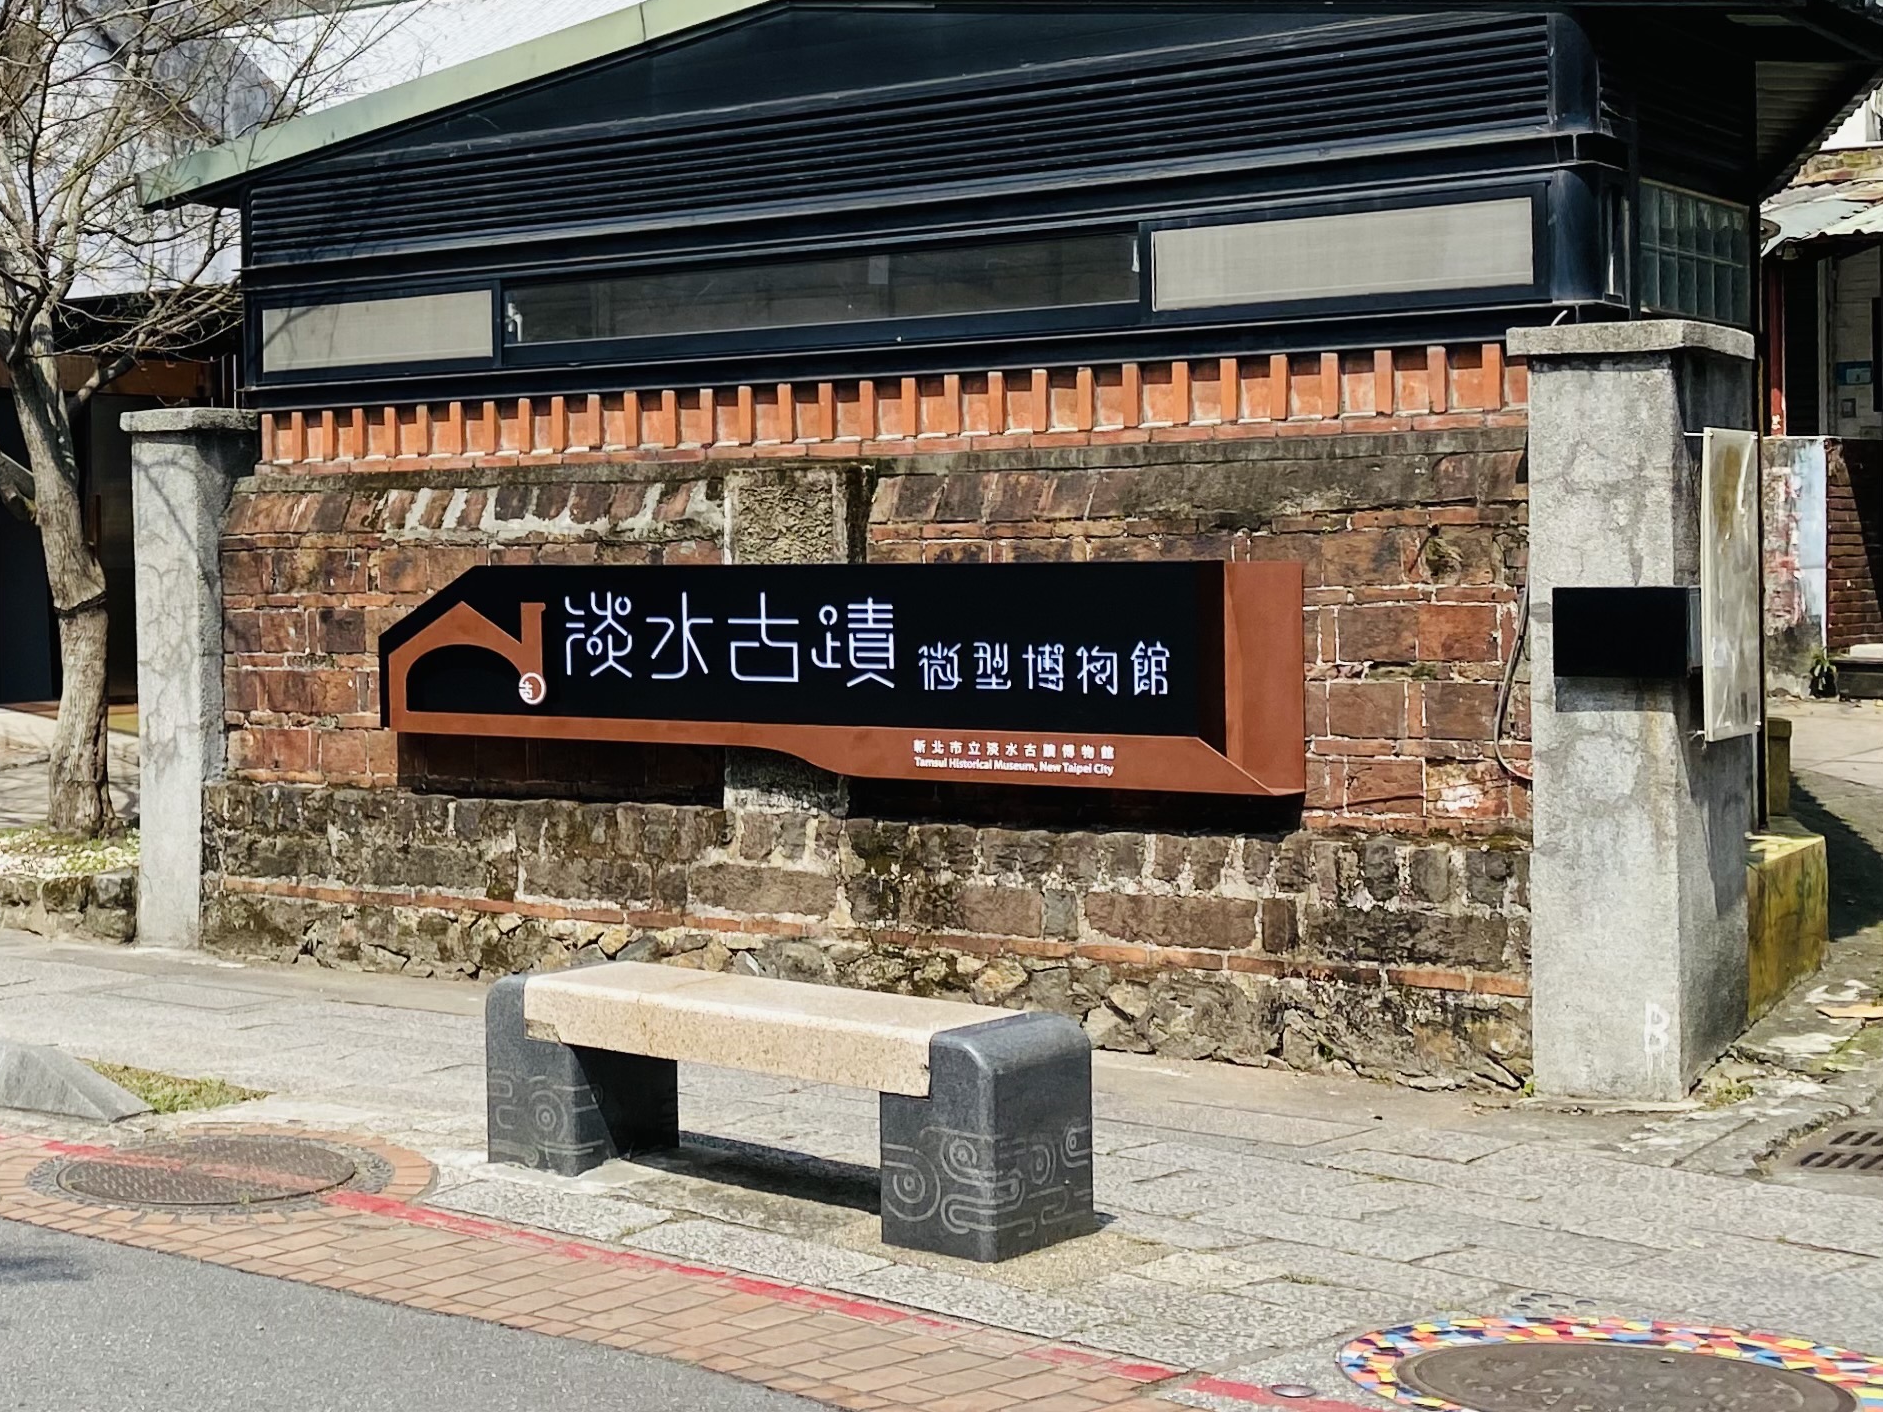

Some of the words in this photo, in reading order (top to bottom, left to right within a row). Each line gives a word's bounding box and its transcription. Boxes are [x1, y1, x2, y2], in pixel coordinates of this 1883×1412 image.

[564, 591, 896, 689] 淡水古蹟
[918, 640, 1171, 696] 微型博物館
[913, 739, 1115, 760] 新北市立淡水古蹟博物館
[914, 757, 947, 768] Tamsui
[949, 758, 992, 770] Historical
[994, 761, 1038, 773] Museum,
[1039, 762, 1061, 773] New
[1062, 762, 1092, 776] Taipei
[1094, 764, 1115, 777] City
